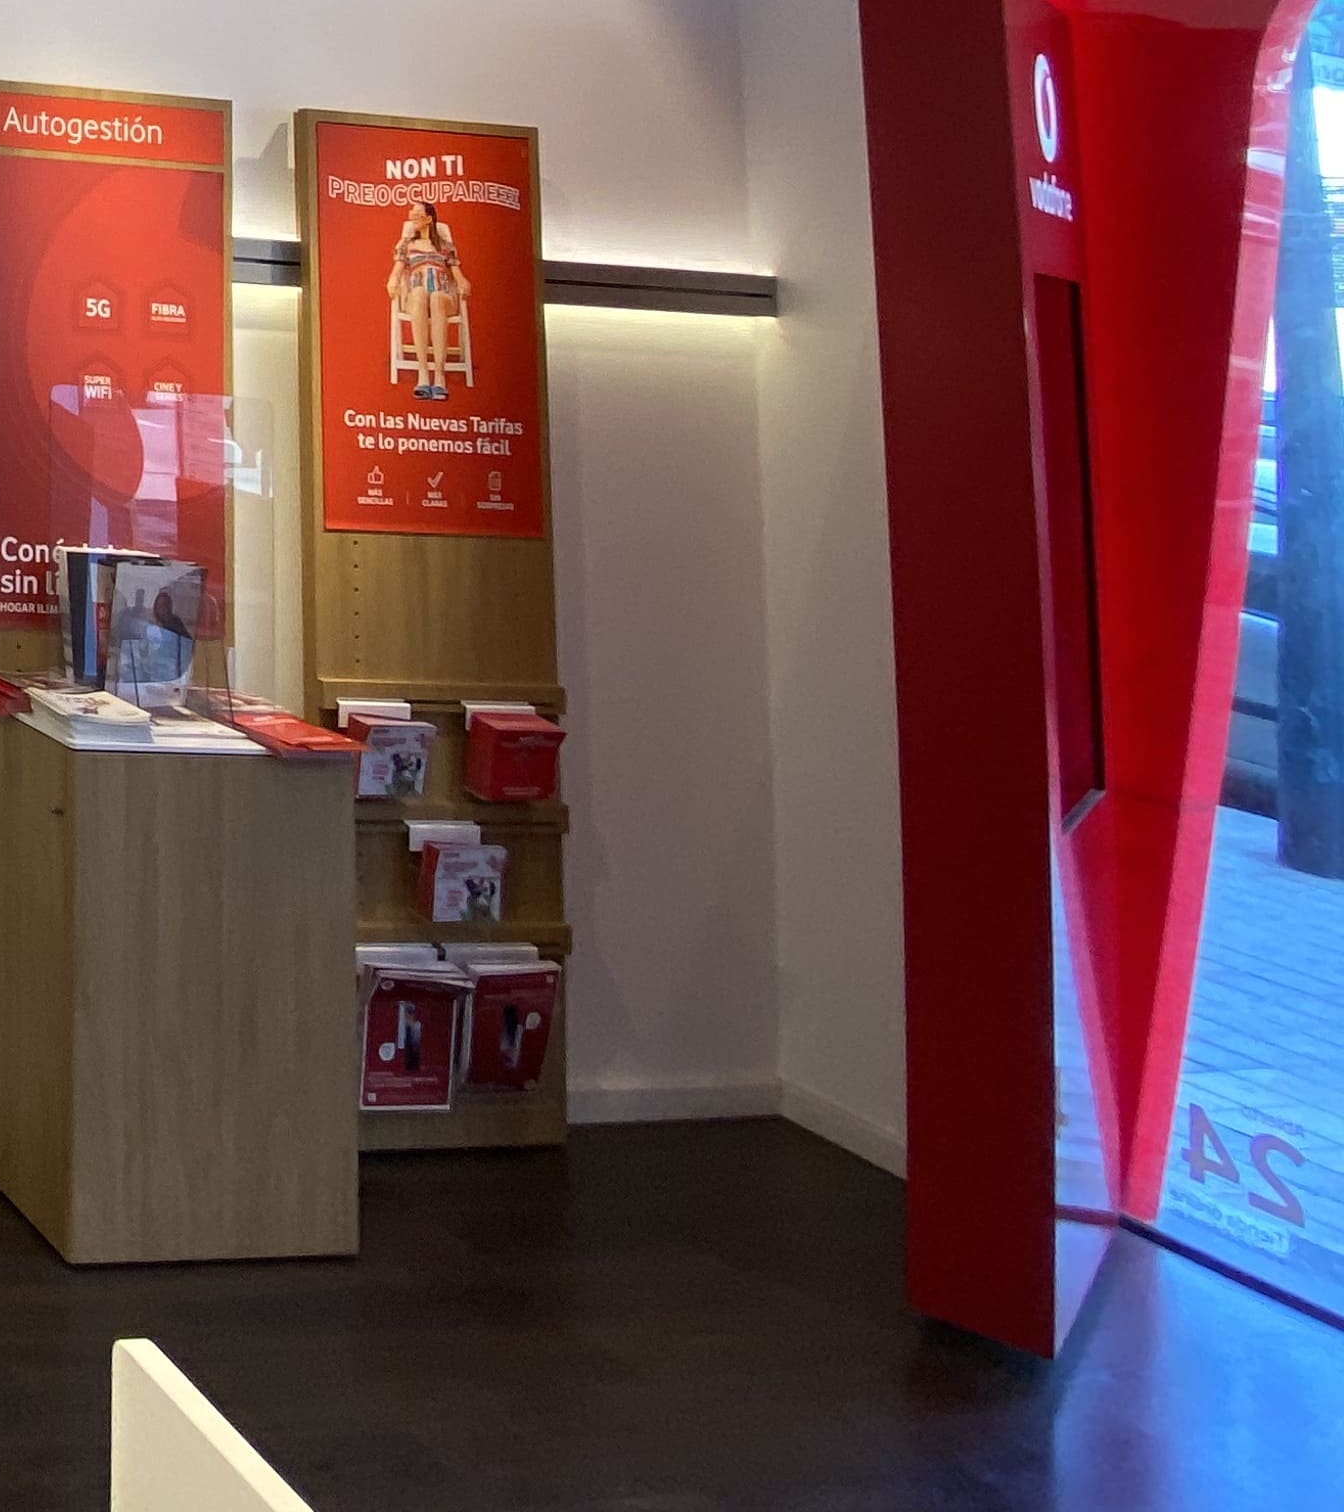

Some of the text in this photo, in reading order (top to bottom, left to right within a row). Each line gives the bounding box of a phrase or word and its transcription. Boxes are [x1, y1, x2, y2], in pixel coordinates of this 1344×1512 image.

[3, 106, 164, 145] Autogestión
[386, 155, 464, 180] NON TI
[85, 297, 111, 318] 5G
[151, 303, 186, 317] FIBRA
[84, 384, 112, 400] WIFI
[153, 382, 183, 392] CINE Y
[343, 409, 523, 436] Con las Nuevas Tarifas
[357, 433, 512, 456] te lo ponemos fácil
[0, 569, 38, 595] sin
[0, 602, 36, 613] HOGAR
